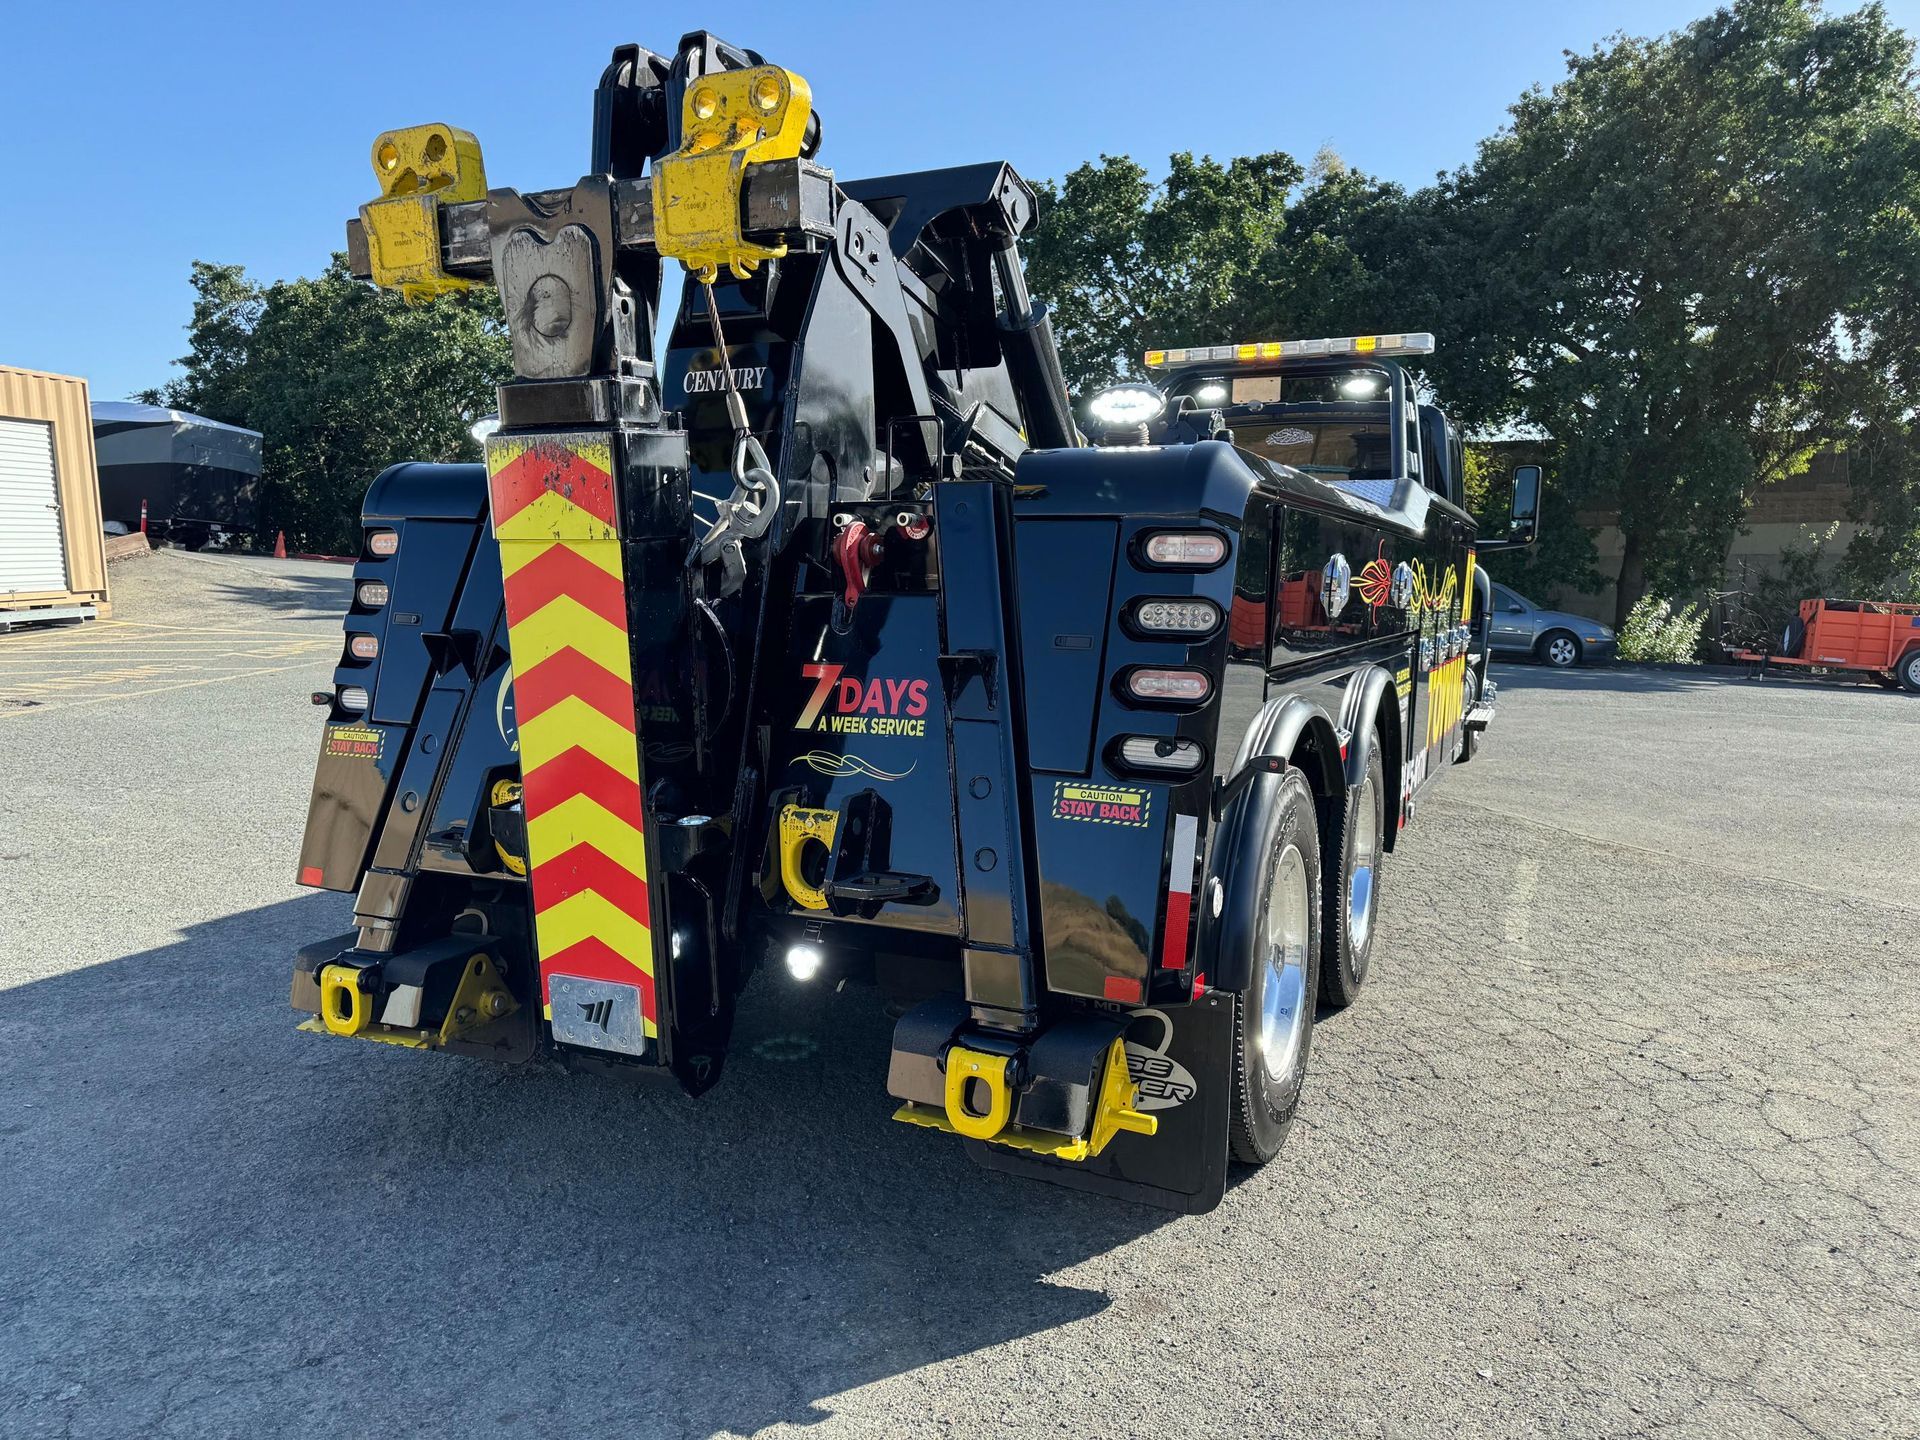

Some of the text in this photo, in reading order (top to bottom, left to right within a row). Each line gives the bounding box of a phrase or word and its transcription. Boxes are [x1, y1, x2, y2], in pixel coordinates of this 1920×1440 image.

[683, 366, 767, 394] CENTURY
[794, 664, 929, 729] 7 DAYS
[343, 732, 369, 740] CAUTION
[818, 716, 926, 737] A WEEK SERVICE
[331, 740, 379, 754] STAY BACK
[1080, 790, 1123, 802] CAUTION
[1060, 800, 1141, 821] STAY BACK
